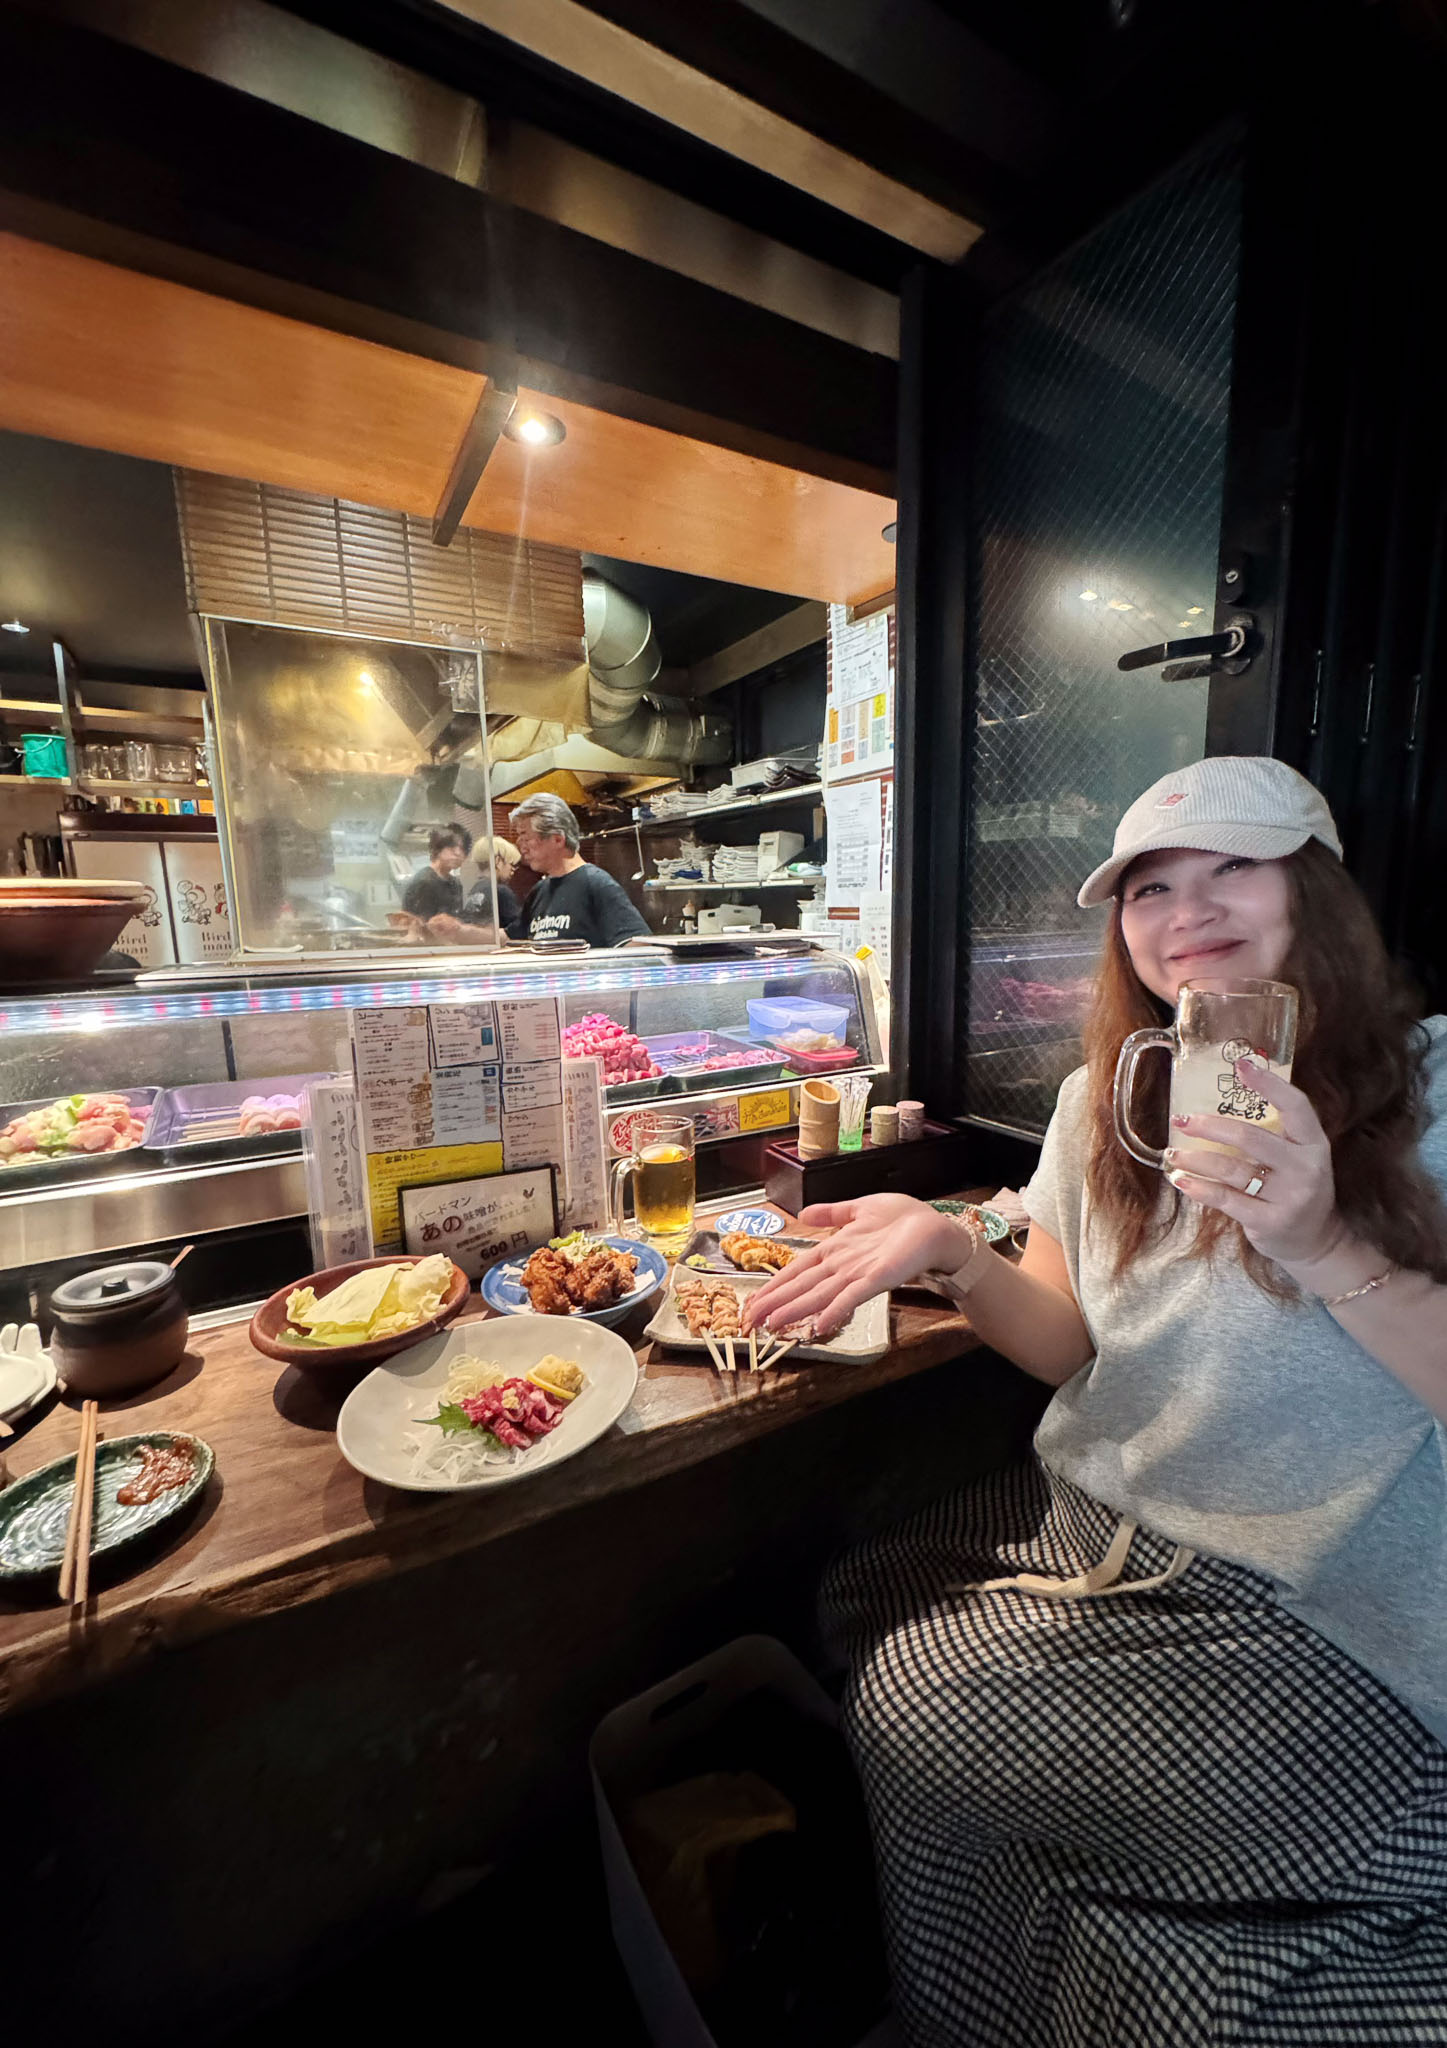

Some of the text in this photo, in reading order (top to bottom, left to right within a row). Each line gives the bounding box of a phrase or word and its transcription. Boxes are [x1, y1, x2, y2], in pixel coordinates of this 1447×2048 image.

[414, 1196, 472, 1224] バードマン
